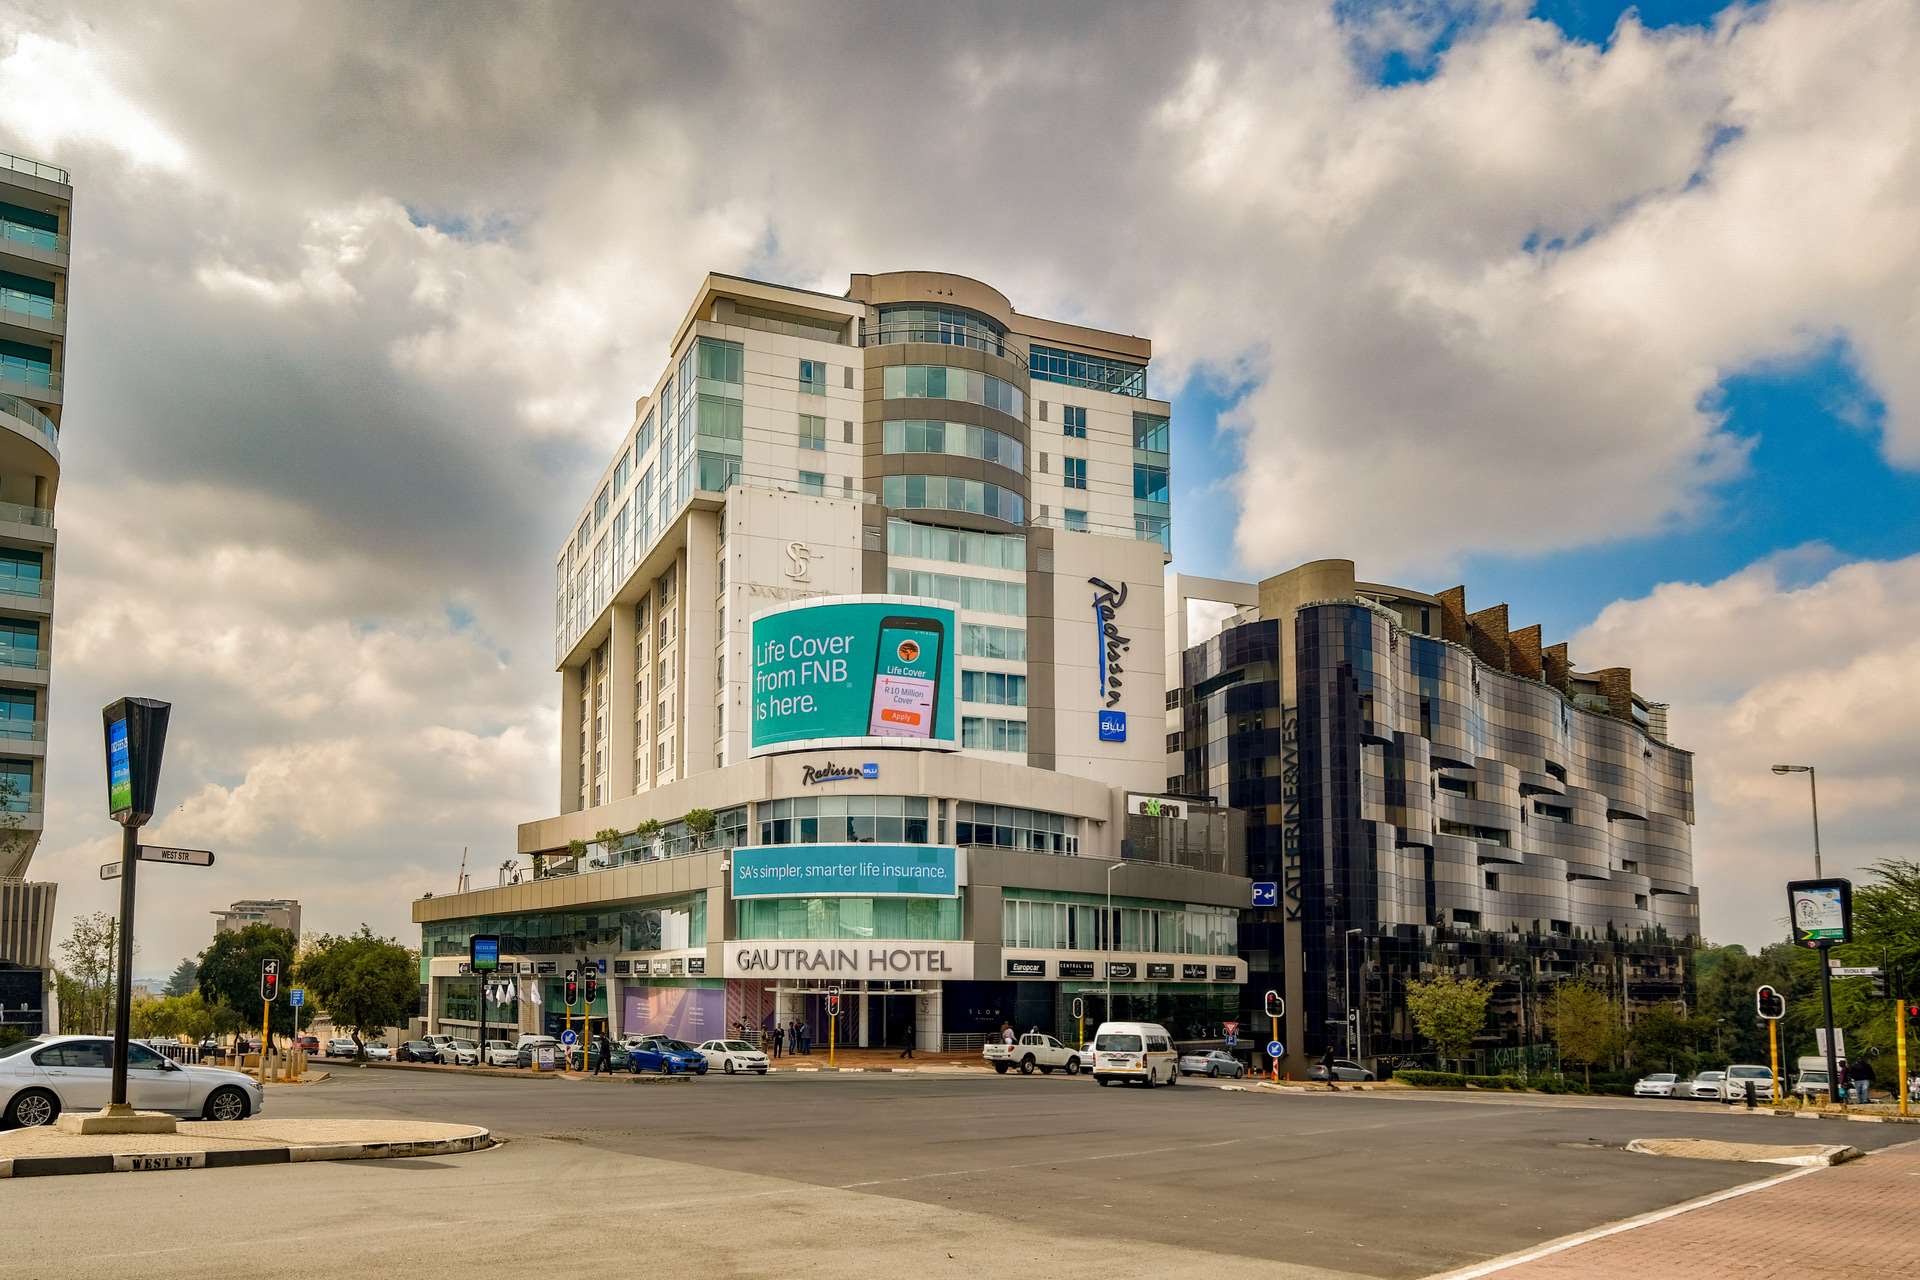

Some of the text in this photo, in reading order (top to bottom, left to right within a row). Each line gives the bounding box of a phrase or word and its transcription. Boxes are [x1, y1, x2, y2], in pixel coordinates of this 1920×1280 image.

[1088, 577, 1130, 708] Radisson
[757, 635, 855, 667] Life Cover
[756, 659, 848, 694] from FNB
[887, 665, 926, 678] Life Cover
[900, 687, 924, 698] Million
[893, 695, 913, 705] Cover
[756, 695, 818, 720] is here.
[891, 713, 912, 722] Apply
[1101, 721, 1125, 732] BLU
[802, 761, 863, 786] Radisson
[161, 850, 190, 861] WEST STR
[739, 862, 947, 880] SA's simpler, smarter life insurance.
[1253, 888, 1263, 900] P
[736, 949, 952, 972] GAUTRAIN HOTEL
[1013, 963, 1040, 972] Europcar
[132, 1156, 193, 1169] WEST ST
